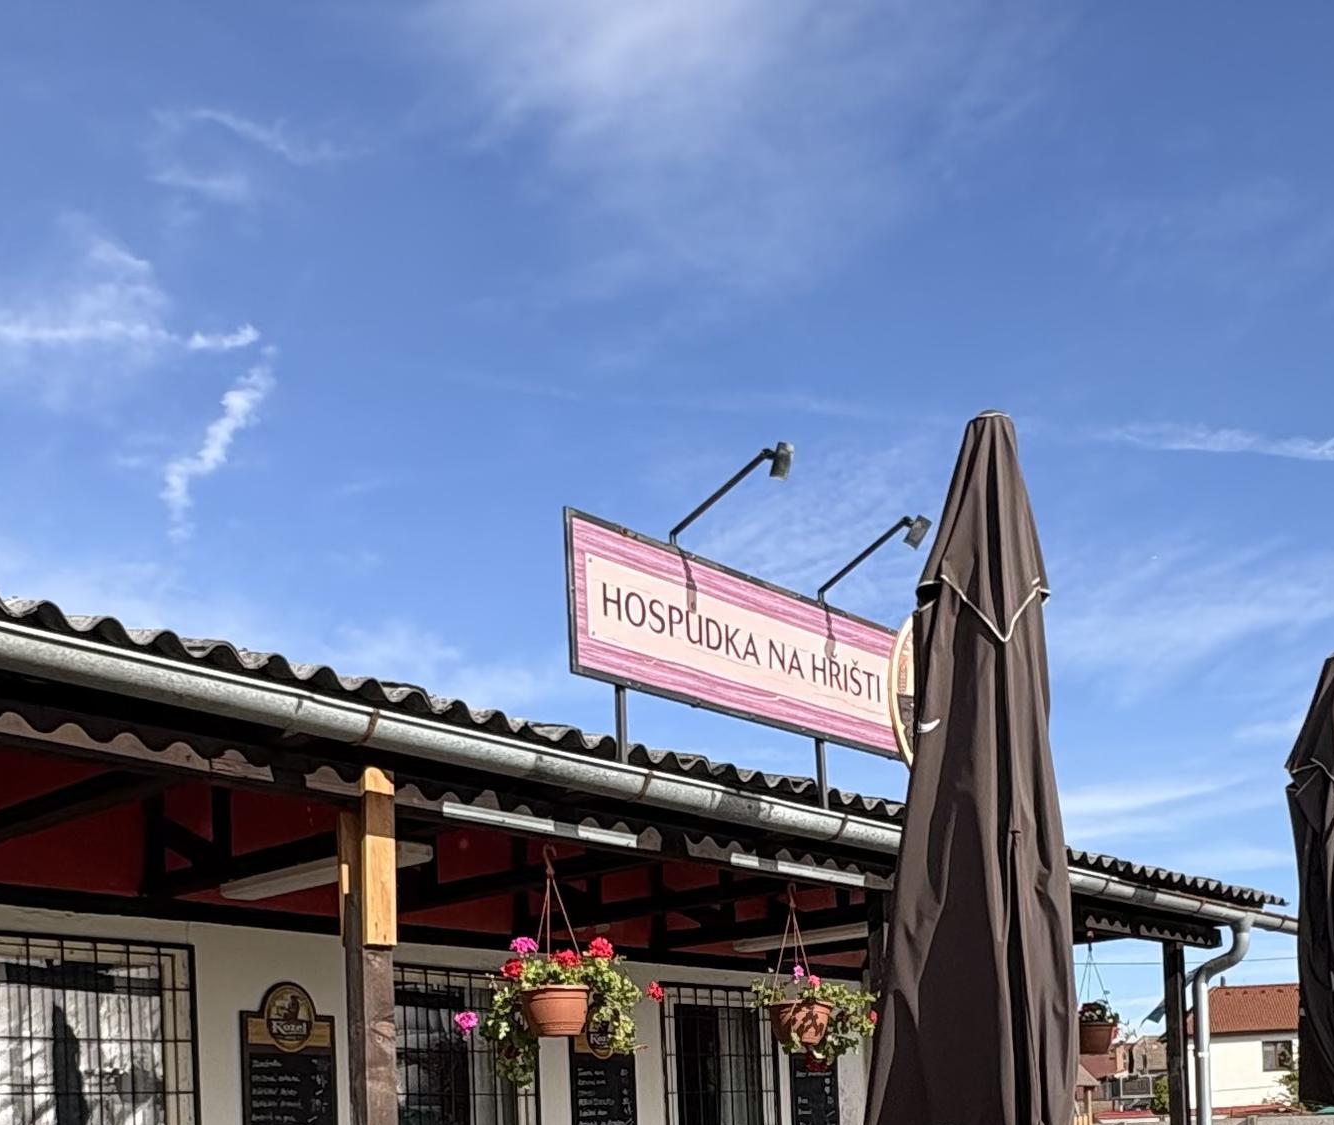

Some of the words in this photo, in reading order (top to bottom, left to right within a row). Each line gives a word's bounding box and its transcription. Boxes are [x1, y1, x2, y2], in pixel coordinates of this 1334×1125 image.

[768, 639, 804, 679] NA
[812, 651, 881, 703] HŘIŠTI
[271, 1020, 308, 1035] Kozel
[589, 1032, 610, 1046] Koz
